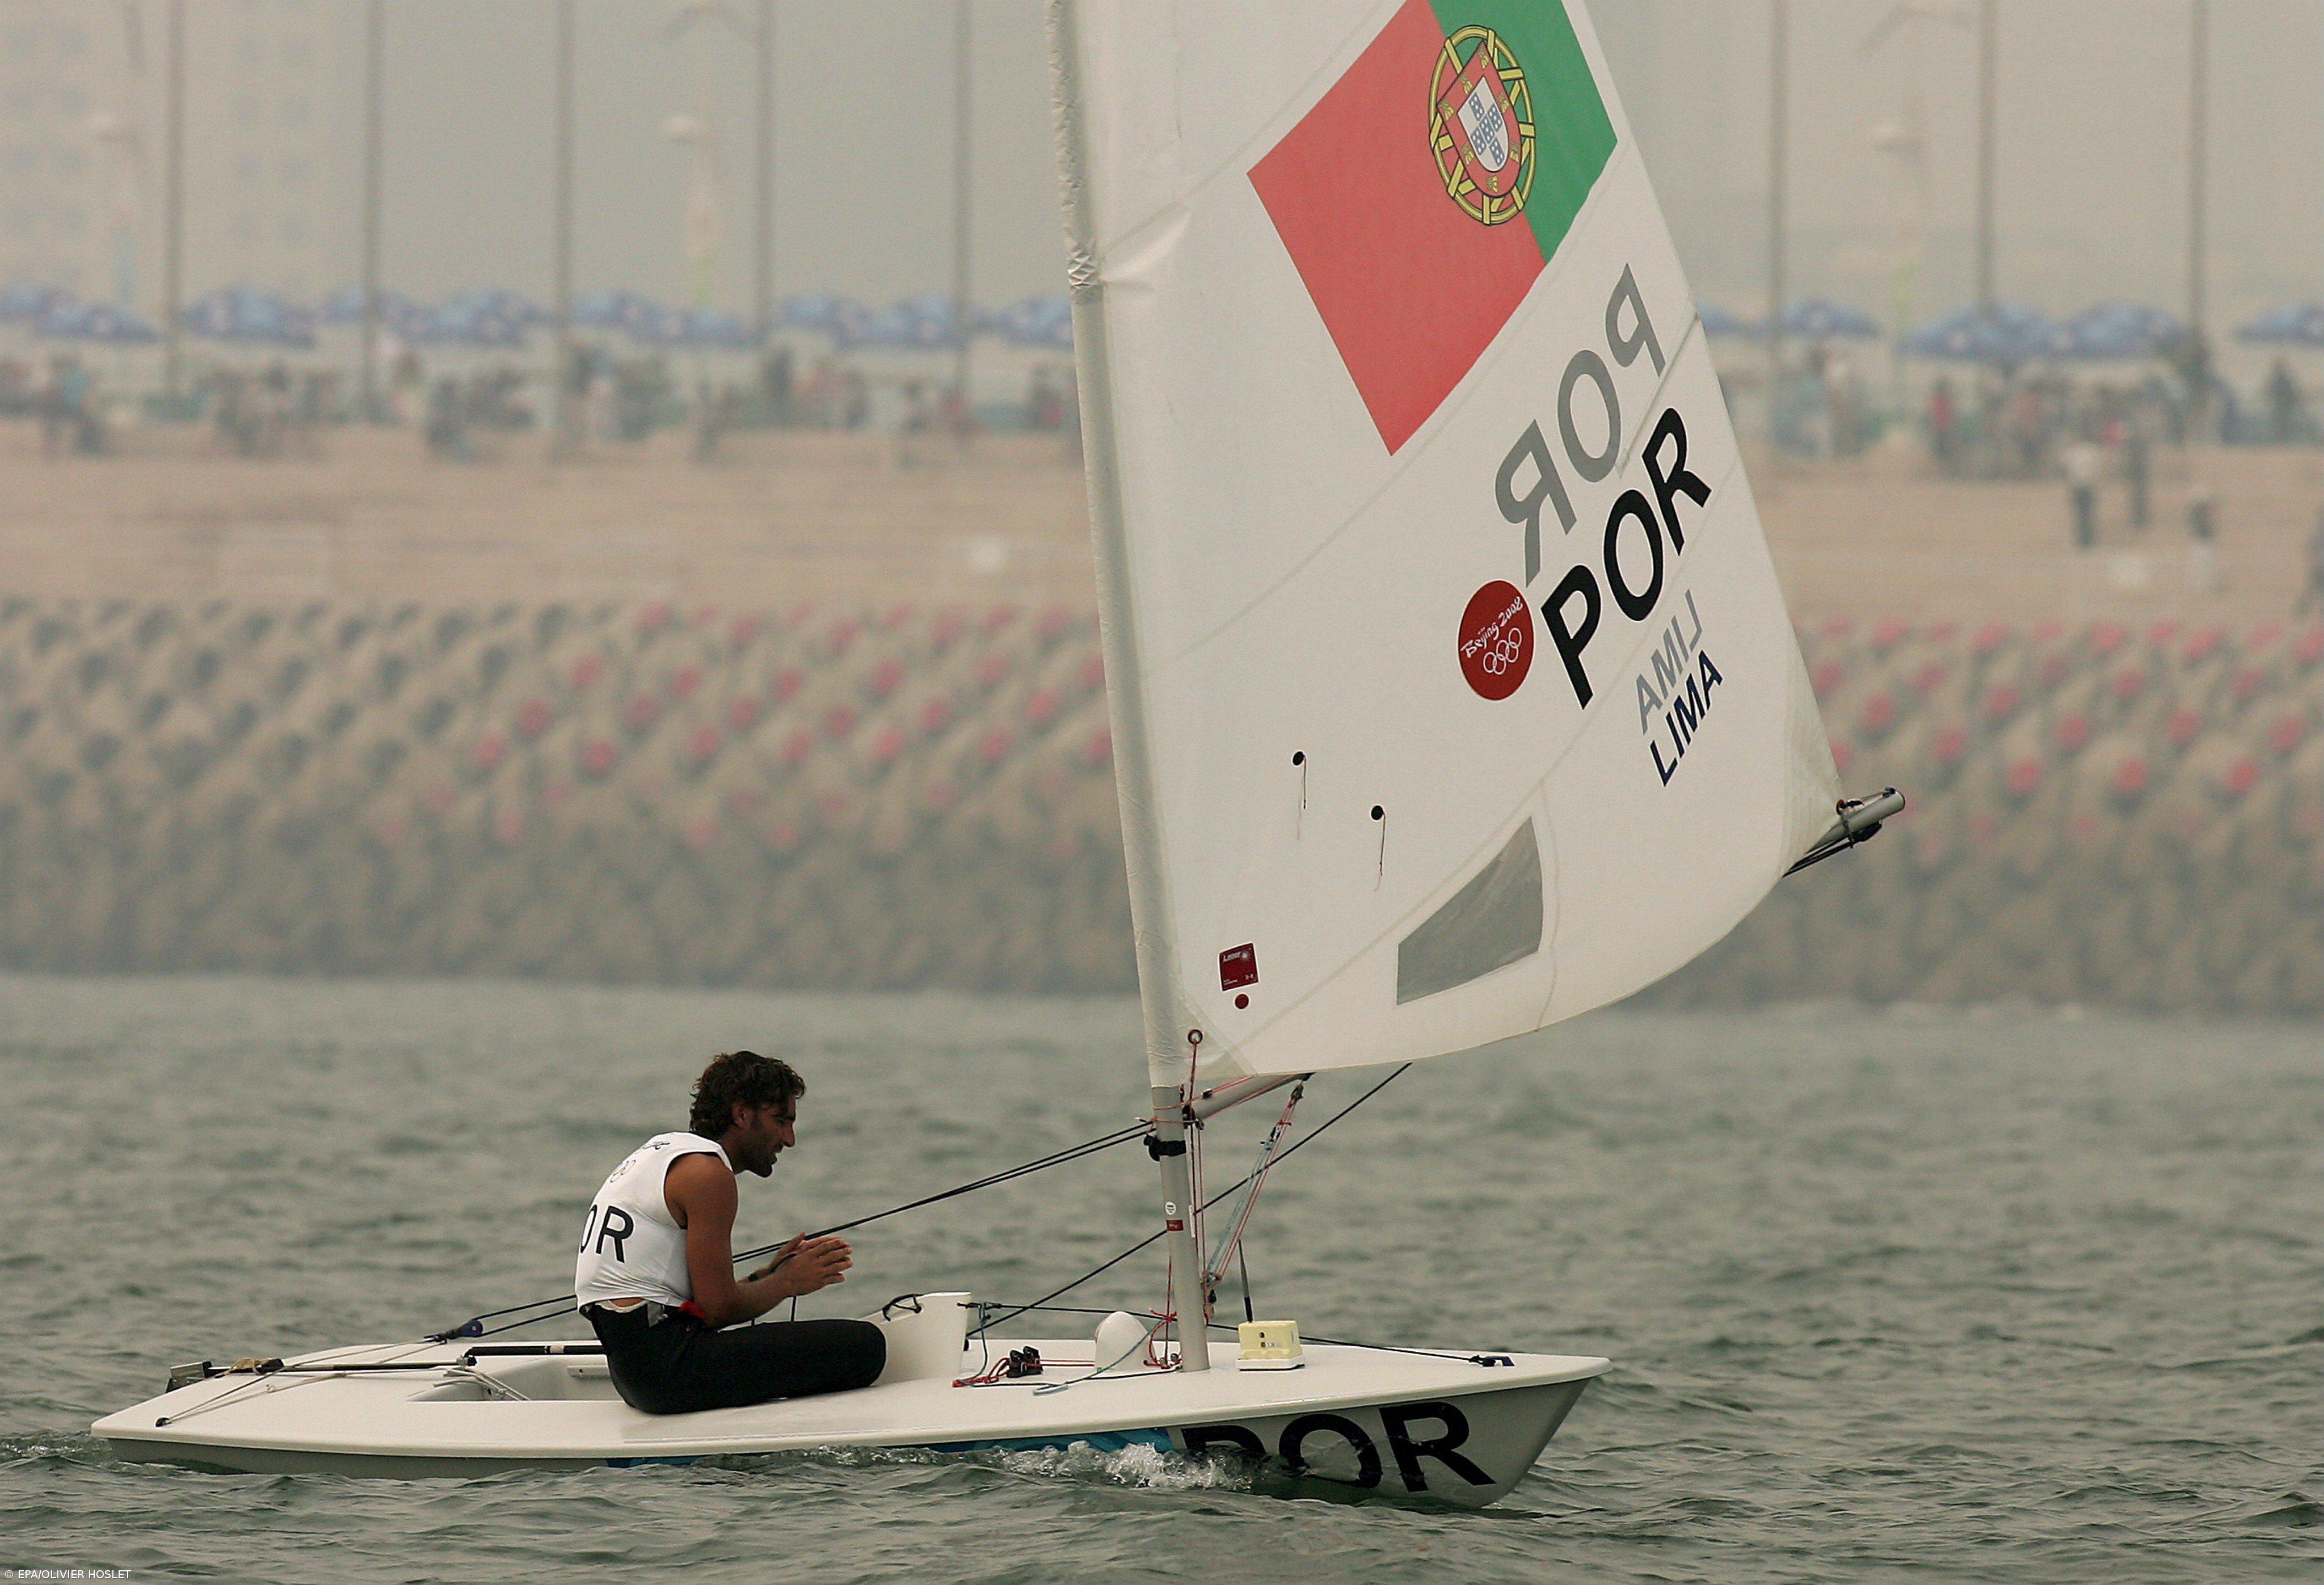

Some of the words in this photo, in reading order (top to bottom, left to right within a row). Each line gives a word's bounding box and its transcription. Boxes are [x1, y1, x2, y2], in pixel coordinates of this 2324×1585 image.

[1460, 622, 1499, 658] Beijing
[1498, 596, 1523, 626] 2008
[1541, 408, 1712, 710] POR
[1650, 650, 1723, 787] LIMA
